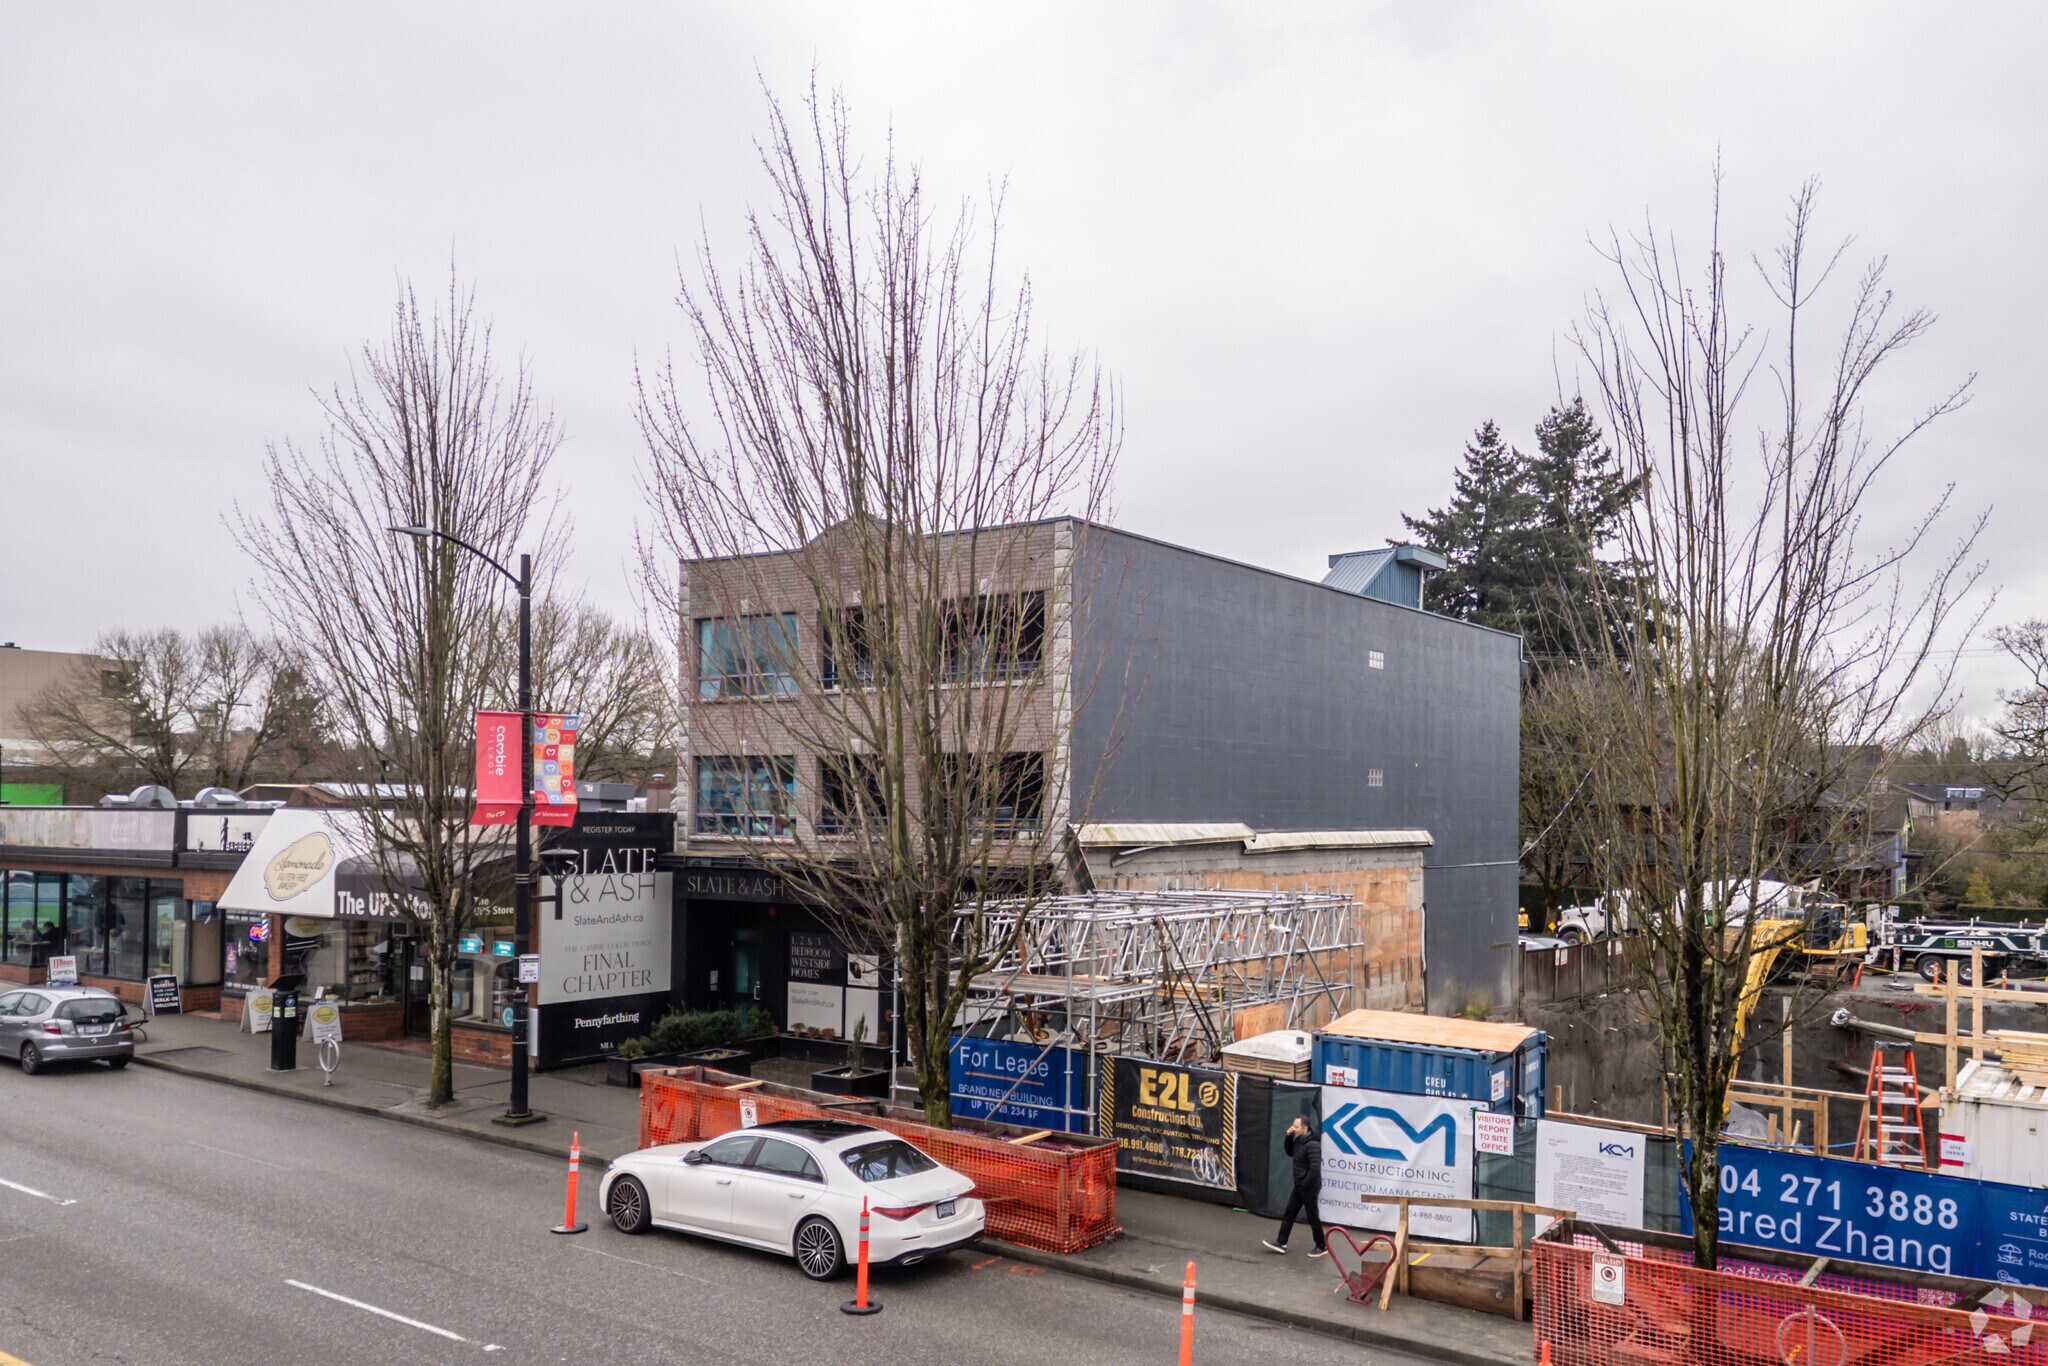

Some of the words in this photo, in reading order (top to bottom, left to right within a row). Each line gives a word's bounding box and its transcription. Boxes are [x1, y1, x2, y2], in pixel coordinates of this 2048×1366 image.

[495, 725, 506, 776] cambie
[582, 826, 613, 834] REGISTER
[614, 825, 636, 833] TODAY
[562, 848, 657, 876] SLATE
[570, 873, 590, 904] &
[598, 872, 656, 903] ASH
[687, 875, 736, 895] SLATE
[738, 877, 749, 895] &
[752, 878, 785, 897] ASH
[337, 890, 365, 916] The
[492, 905, 515, 914] Store
[573, 913, 644, 926] SlateAndAsh.ca
[1957, 939, 1995, 947] SIDHU
[791, 946, 831, 958] BEDROOM
[583, 951, 634, 972] FINAL
[791, 957, 832, 969] WESTSIDE
[790, 967, 820, 979] HOMES
[563, 969, 653, 994] CHAPTER
[791, 996, 835, 1008] SlateAndAsh.ca
[574, 1012, 640, 1029] Pennyfarthing
[959, 1046, 989, 1068] For
[994, 1050, 1049, 1078] Lease
[1425, 1076, 1446, 1088] CREU
[958, 1084, 988, 1096] BRAND
[1010, 1091, 1054, 1106] BUILDING
[1139, 1067, 1196, 1112] E2L
[971, 1100, 982, 1109] UP
[985, 1102, 995, 1112] TO
[1131, 1105, 1186, 1126] Construction
[1476, 1115, 1512, 1125] VISITORS
[1478, 1124, 1510, 1134] REPORT
[1479, 1133, 1490, 1141] TO
[1491, 1135, 1508, 1143] SITE
[1481, 1142, 1509, 1152] OFFICE
[1599, 1142, 1634, 1158] KCM
[1428, 1170, 1455, 1184] INC.
[1321, 1178, 1376, 1193] STRUCTION
[1720, 1164, 1762, 1198] 04
[1780, 1173, 1841, 1211] 271
[1865, 1186, 1959, 1230] 3888
[1320, 1198, 1369, 1212] ONSTRUCTION
[1408, 1210, 1452, 1222] 04-988-8800
[1717, 1206, 1801, 1245] ared
[1815, 1215, 1952, 1276] Zhang
